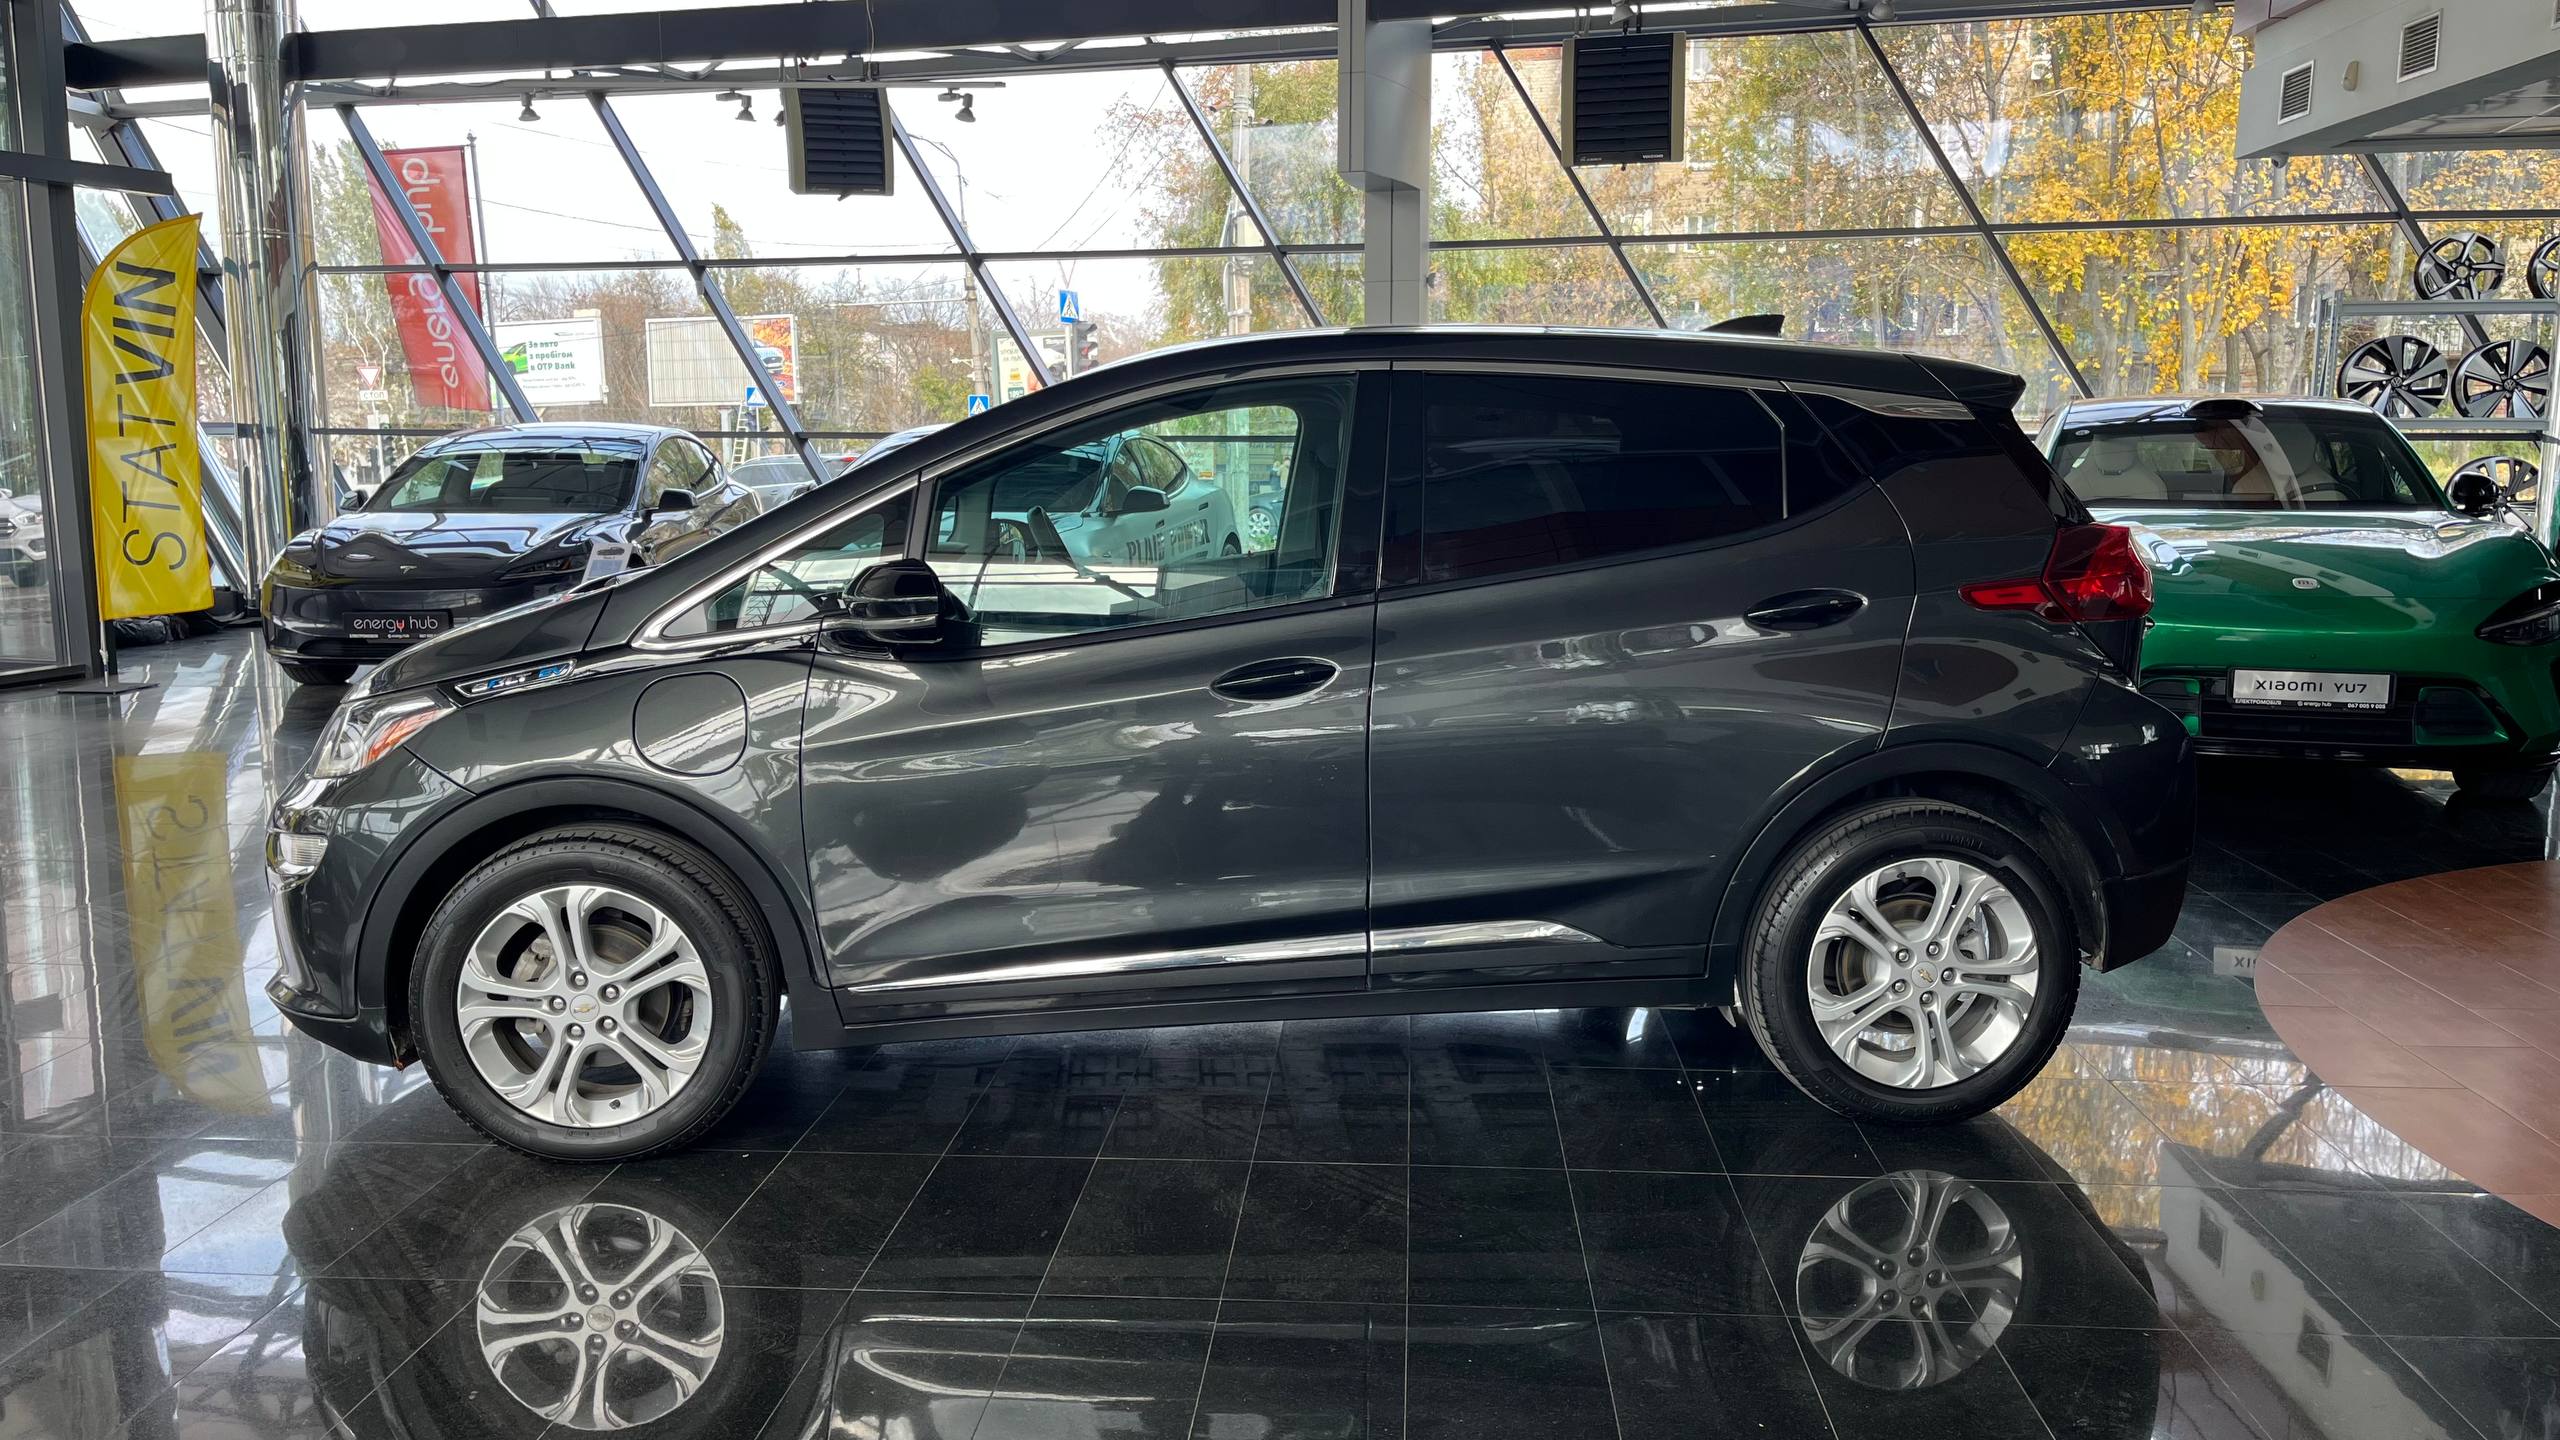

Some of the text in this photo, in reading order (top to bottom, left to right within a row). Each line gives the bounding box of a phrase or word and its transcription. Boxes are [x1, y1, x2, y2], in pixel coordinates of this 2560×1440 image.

[111, 260, 188, 572] STATVIN
[353, 616, 439, 633] energy hub
[2333, 682, 2368, 694] YU7
